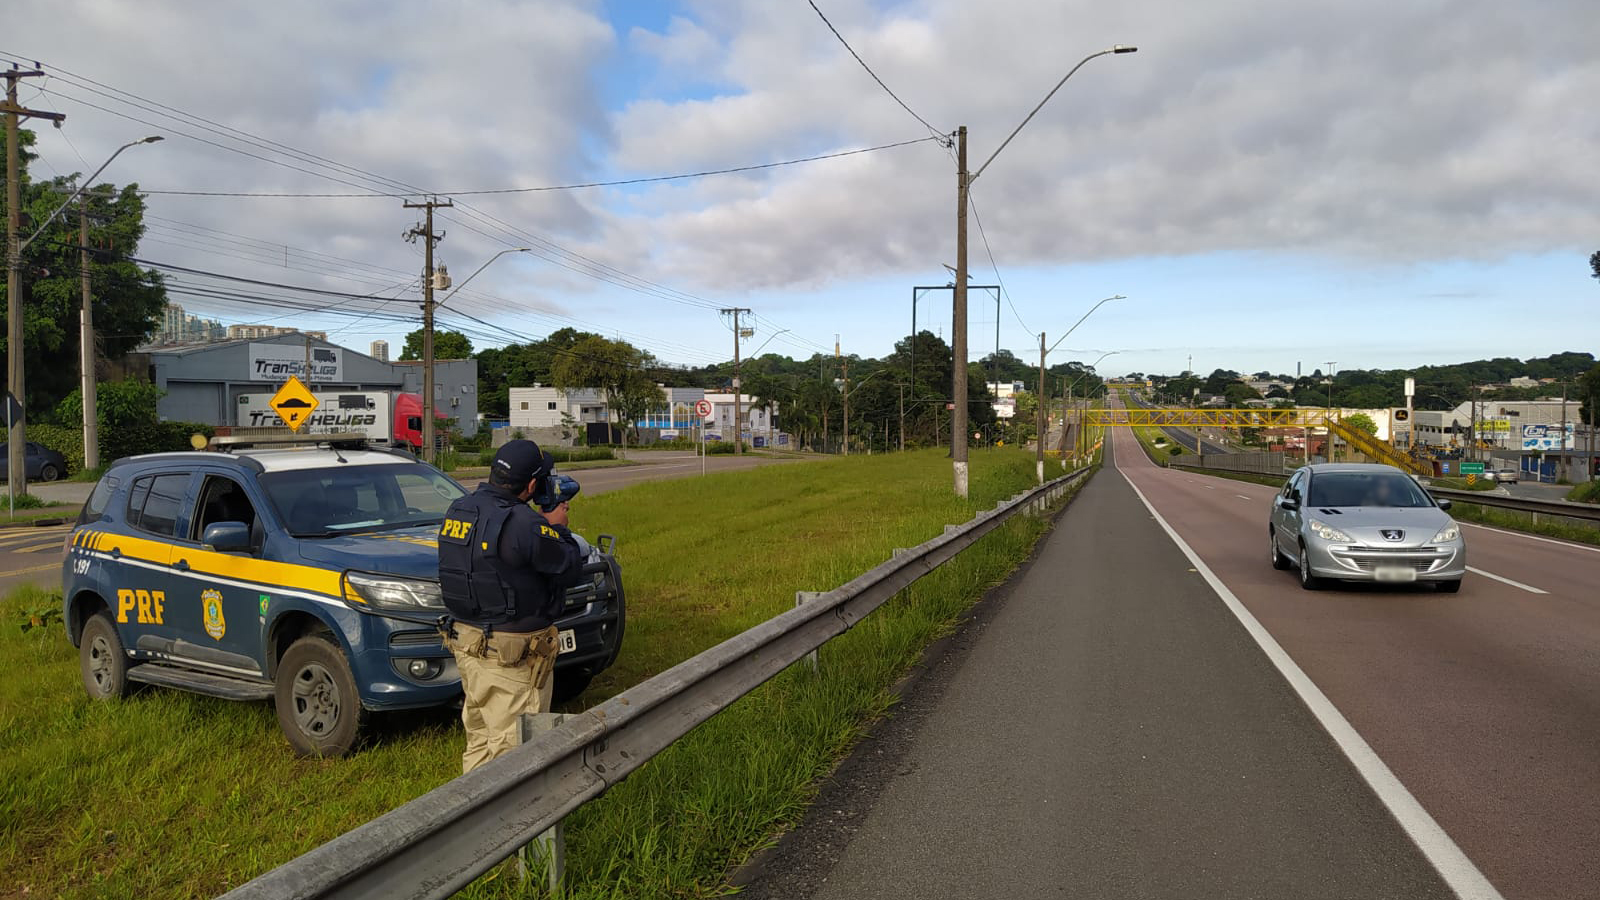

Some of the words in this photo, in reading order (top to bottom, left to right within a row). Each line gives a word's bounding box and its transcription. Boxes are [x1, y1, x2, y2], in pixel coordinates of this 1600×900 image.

[700, 403, 706, 413] E
[441, 518, 472, 539] PRF
[77, 558, 91, 576] 191
[117, 589, 165, 625] PRF
